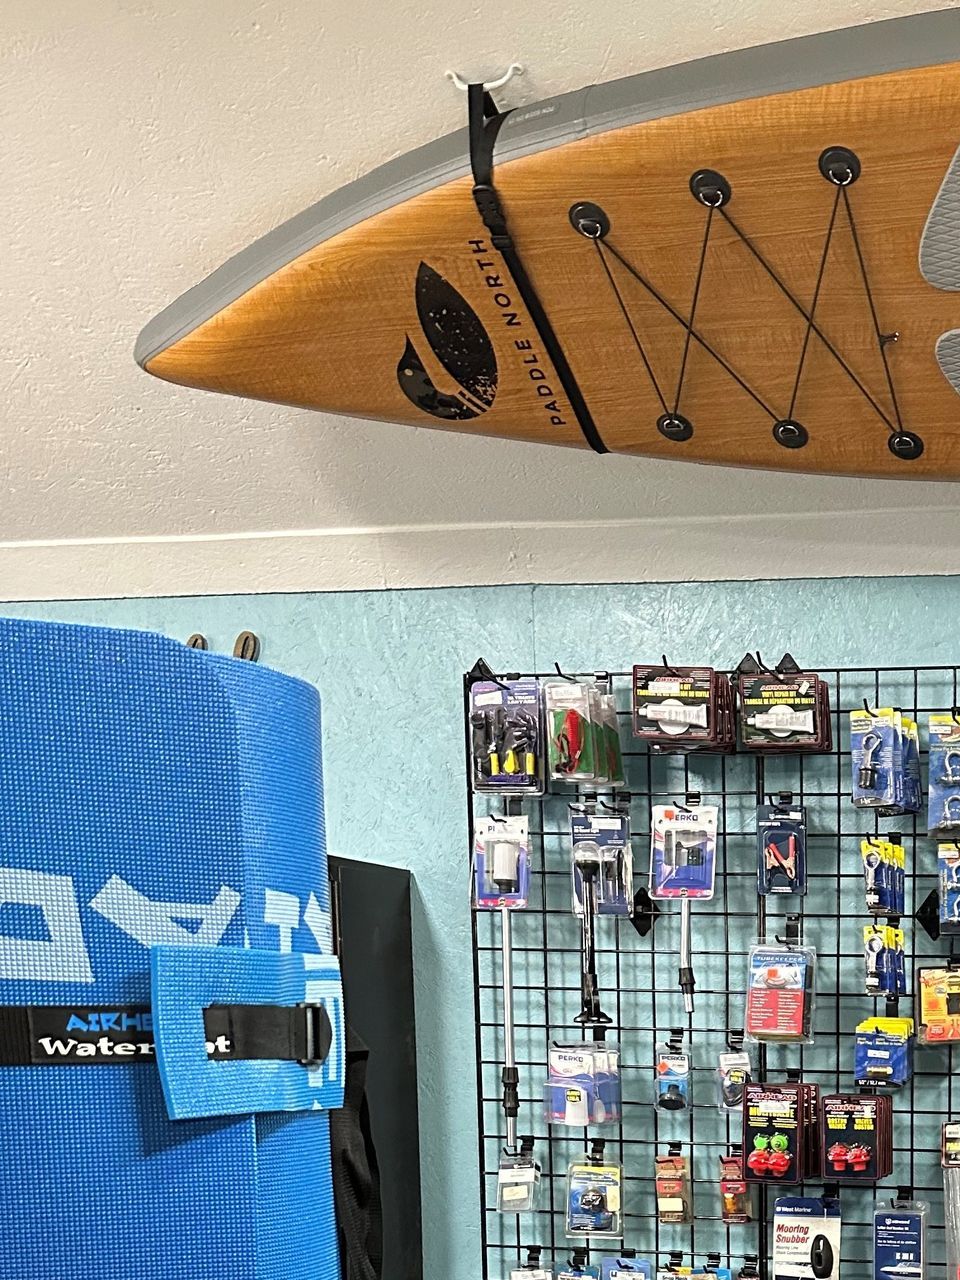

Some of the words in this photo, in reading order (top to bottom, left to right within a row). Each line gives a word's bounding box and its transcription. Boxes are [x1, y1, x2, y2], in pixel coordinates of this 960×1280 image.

[468, 239, 521, 327] NORTH
[515, 339, 566, 426] PADDLE
[776, 1224, 809, 1235] Mooring
[776, 1234, 810, 1243] Snubber
